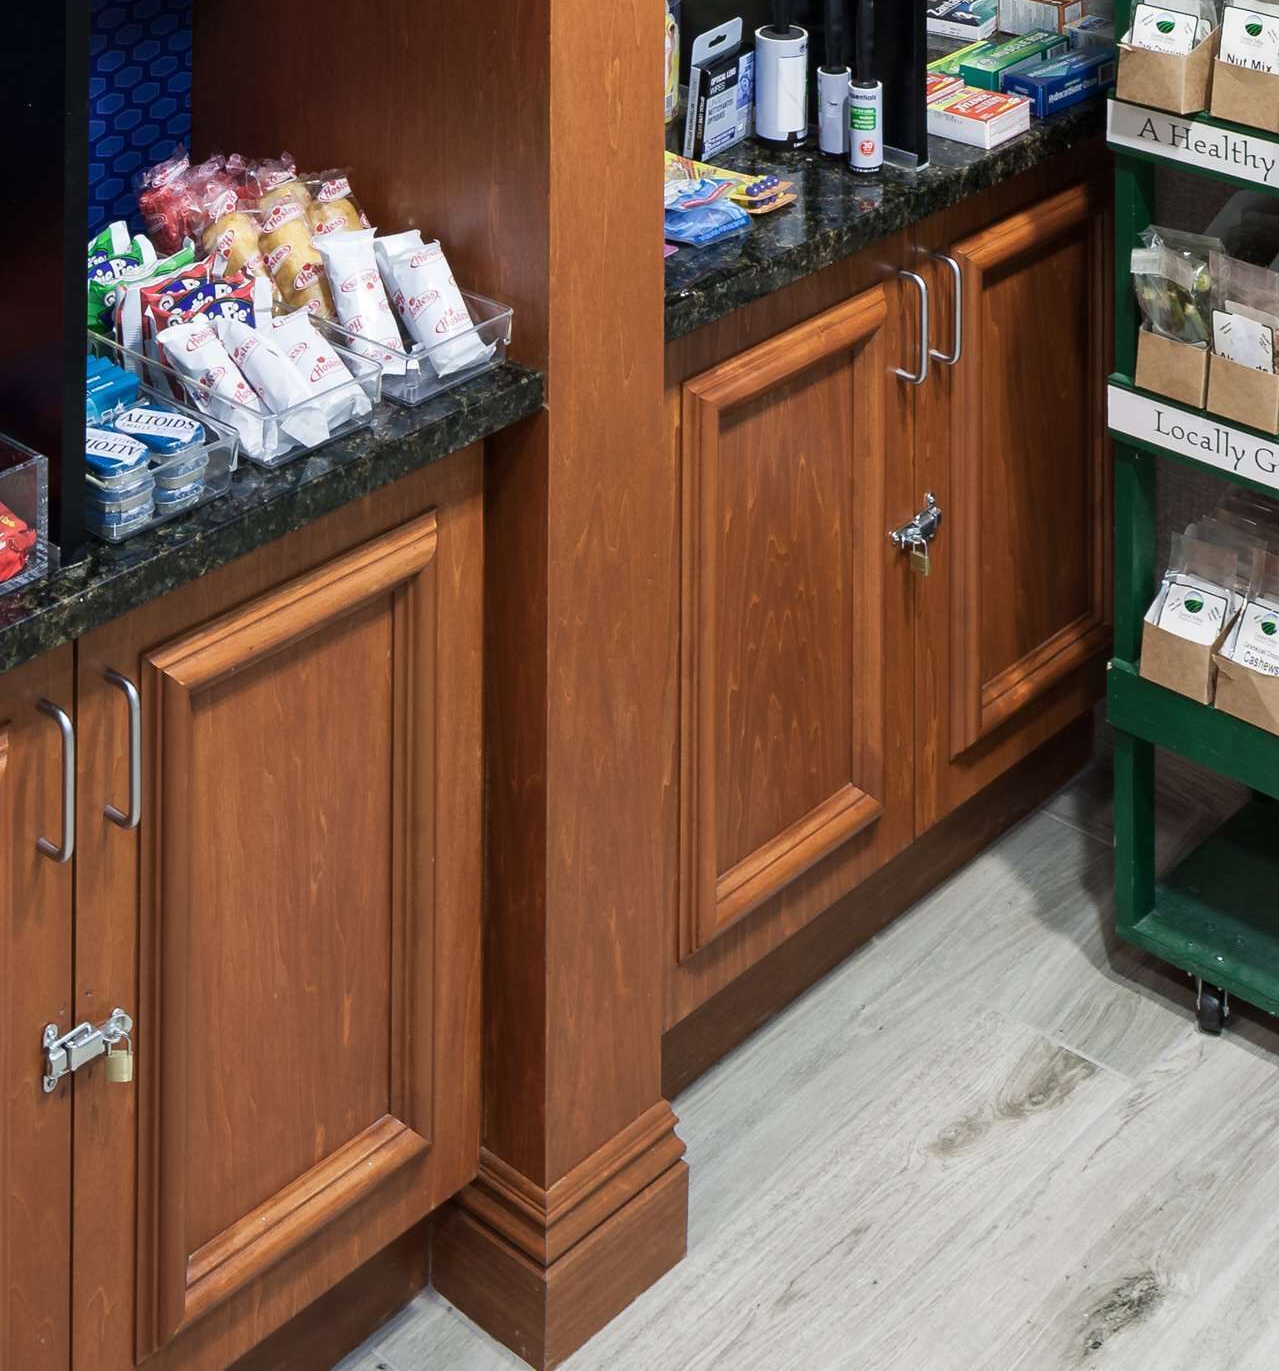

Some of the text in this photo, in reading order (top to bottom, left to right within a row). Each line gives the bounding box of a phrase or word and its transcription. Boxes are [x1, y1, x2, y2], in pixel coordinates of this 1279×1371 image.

[1226, 52, 1272, 73] Nut Mix
[1138, 117, 1161, 142] A
[1168, 123, 1275, 182] Healthy
[121, 411, 195, 429] ALTOIDS
[86, 439, 143, 456] ALTOI
[1154, 408, 1246, 470] Locally
[1243, 650, 1279, 676] Cashews
